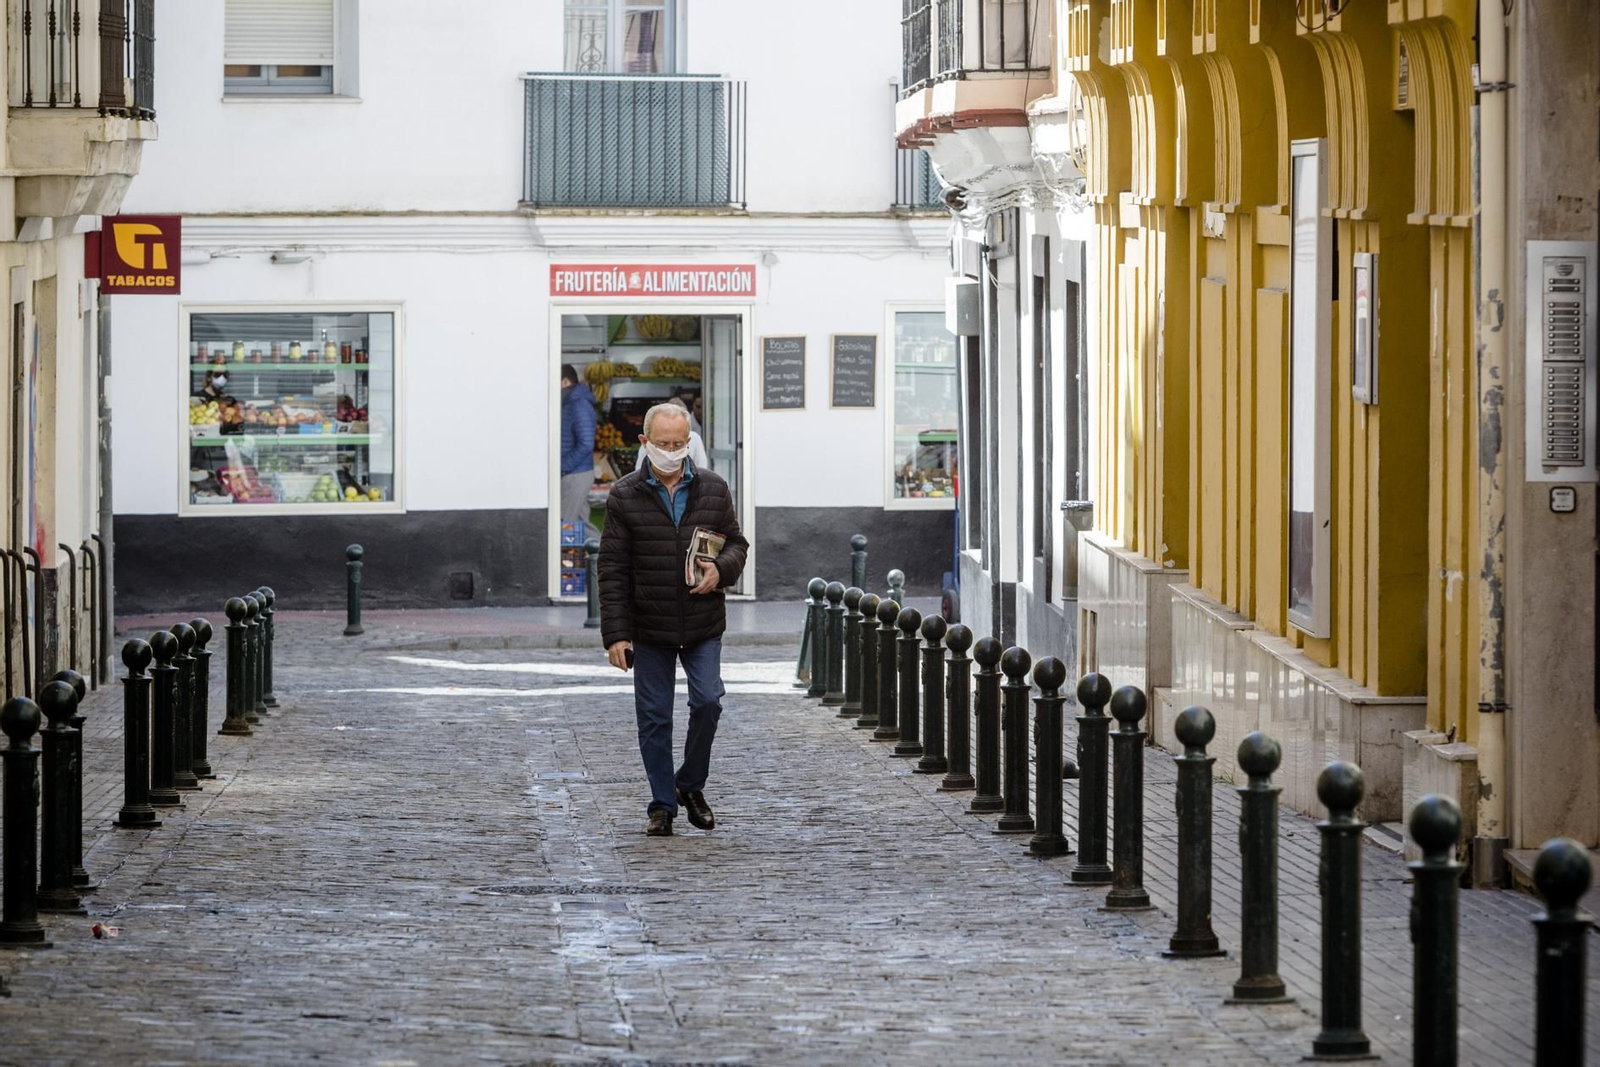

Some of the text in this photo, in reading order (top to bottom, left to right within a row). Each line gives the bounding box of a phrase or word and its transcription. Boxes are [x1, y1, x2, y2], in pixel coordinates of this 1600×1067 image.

[106, 275, 175, 287] TABACOS
[555, 267, 752, 292] FRUTERÍA ALIMENTACIÓN
